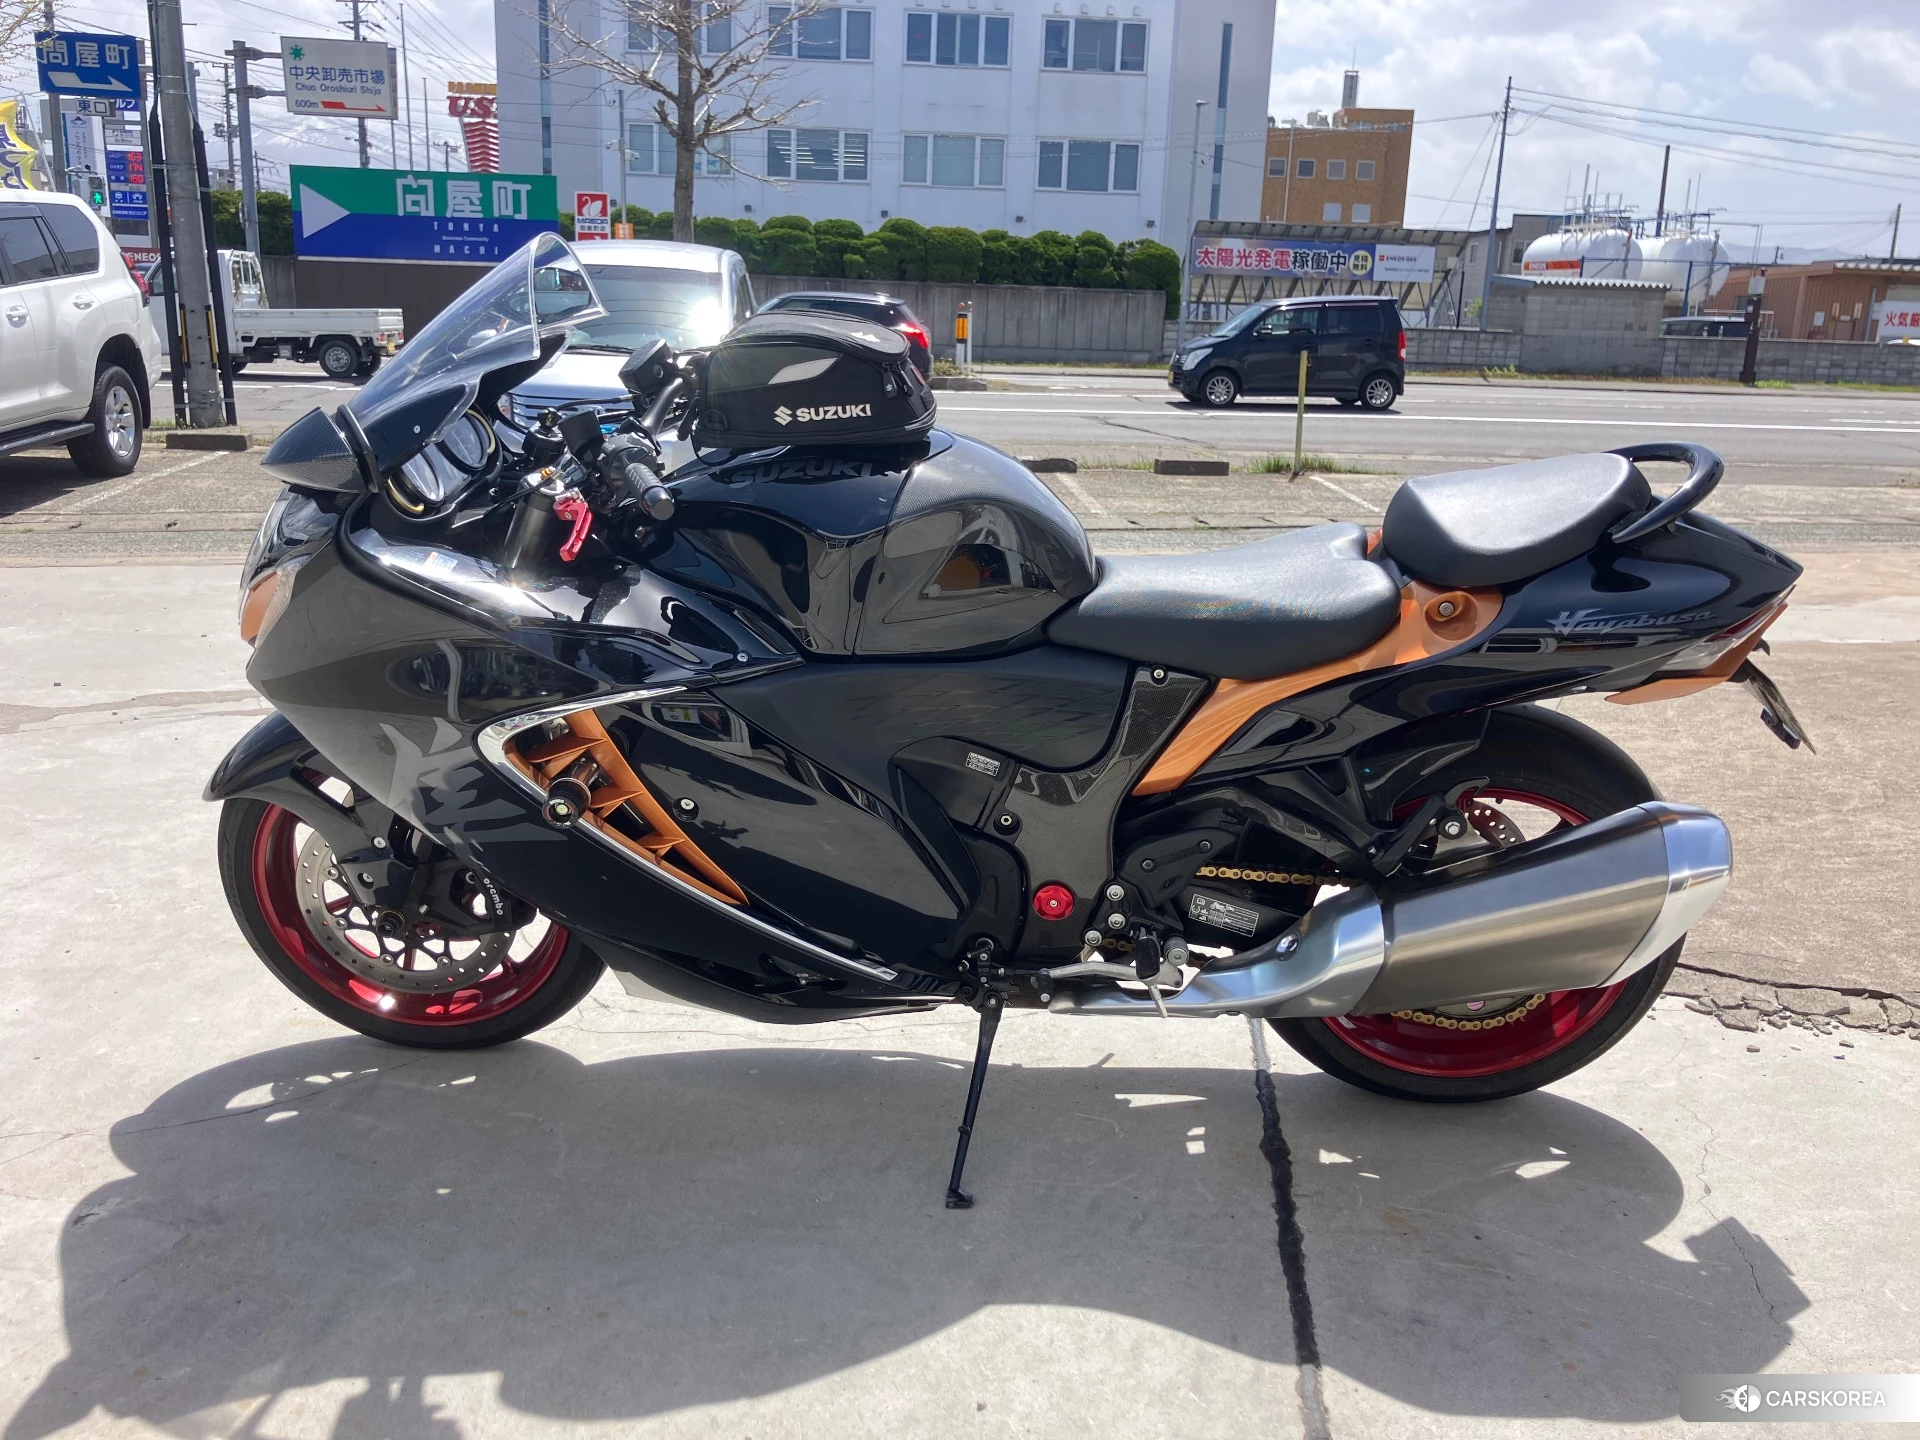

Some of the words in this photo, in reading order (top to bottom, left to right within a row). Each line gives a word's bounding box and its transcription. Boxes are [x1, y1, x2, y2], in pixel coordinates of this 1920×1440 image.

[289, 65, 386, 85] 中央卸売市場
[295, 82, 317, 92] Chuo
[320, 84, 358, 94] Oroshiuri
[360, 86, 382, 96] Shijo
[77, 99, 107, 114] 東口
[295, 99, 319, 109] 600m
[433, 221, 499, 232] TONYA
[434, 245, 499, 255] MACHI
[1196, 247, 1347, 272] 太陽光発電稼働中
[796, 403, 872, 422] SUZUKI
[730, 457, 874, 489] SUZUKI
[1546, 607, 1718, 636] Hayabusa
